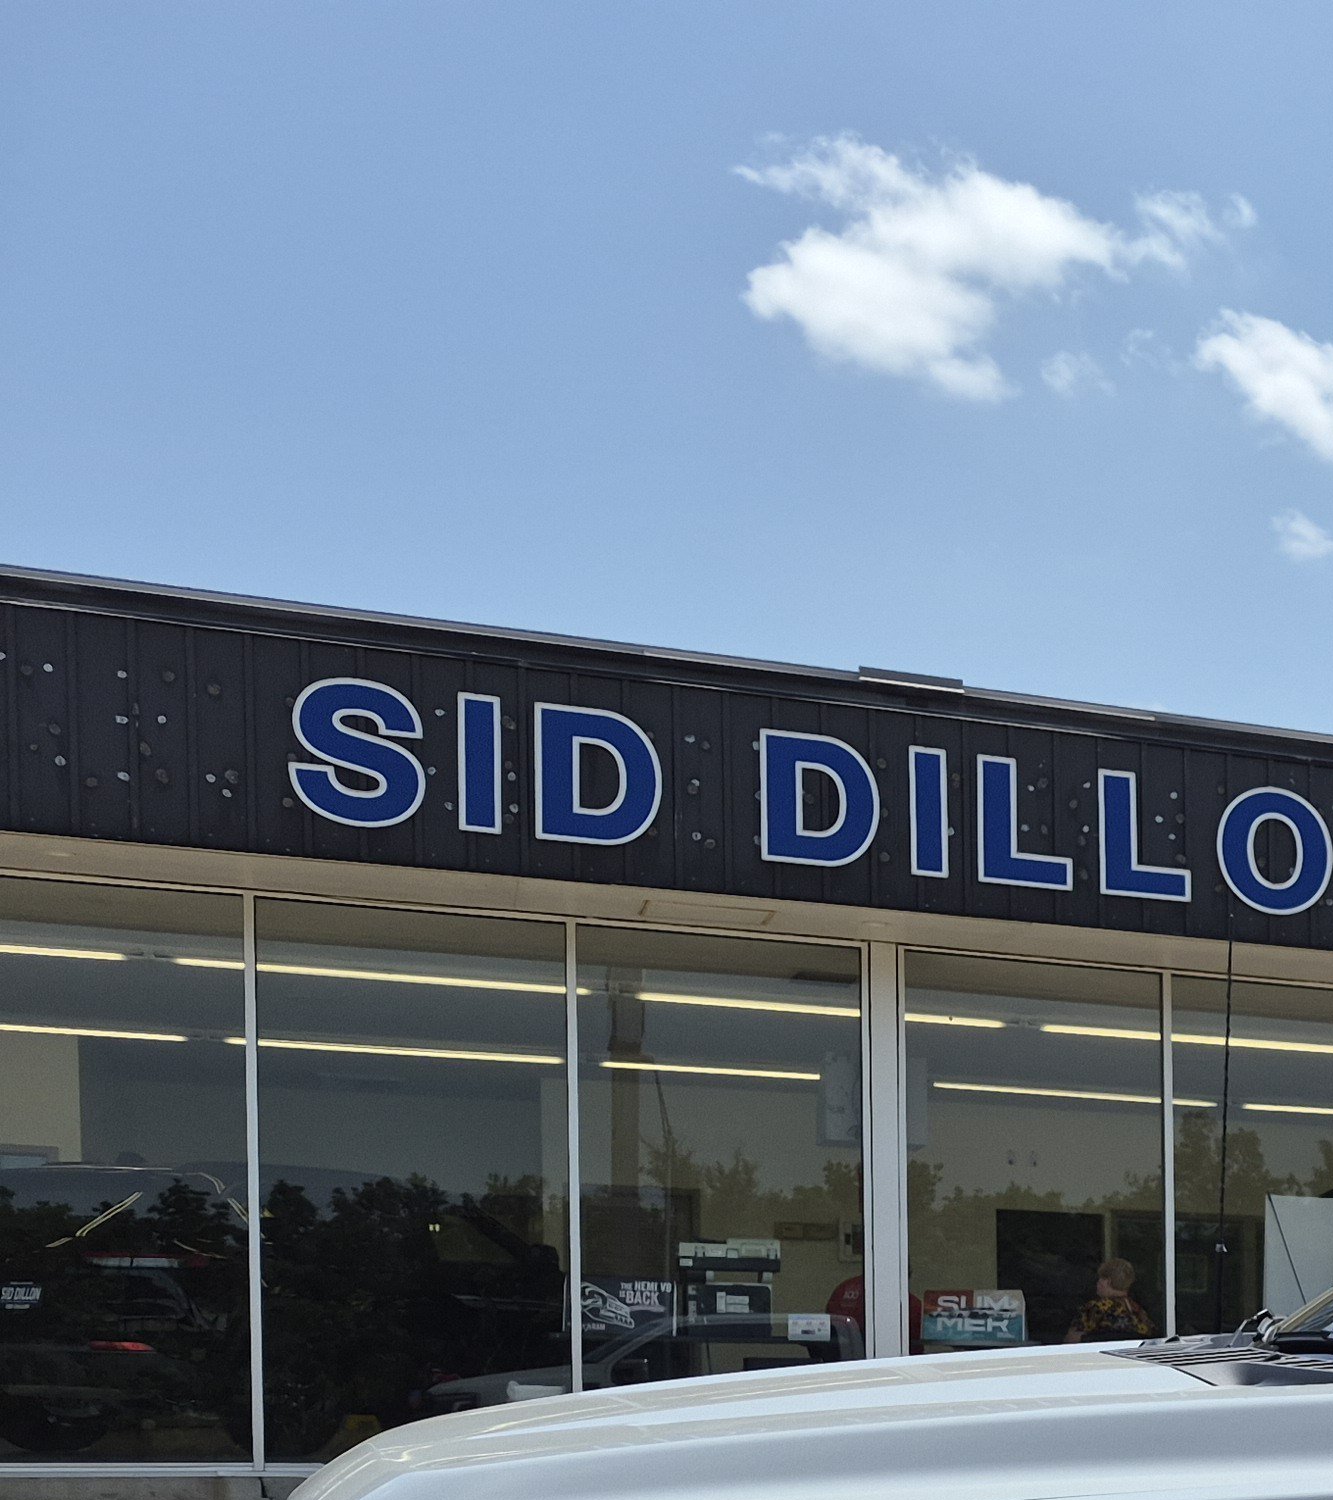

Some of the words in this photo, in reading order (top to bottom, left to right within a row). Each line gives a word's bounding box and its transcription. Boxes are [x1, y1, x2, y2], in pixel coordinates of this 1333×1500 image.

[287, 676, 663, 848] SID
[634, 1281, 658, 1291] HEMI
[625, 1290, 659, 1306] BACK
[937, 1317, 1009, 1332] MER
